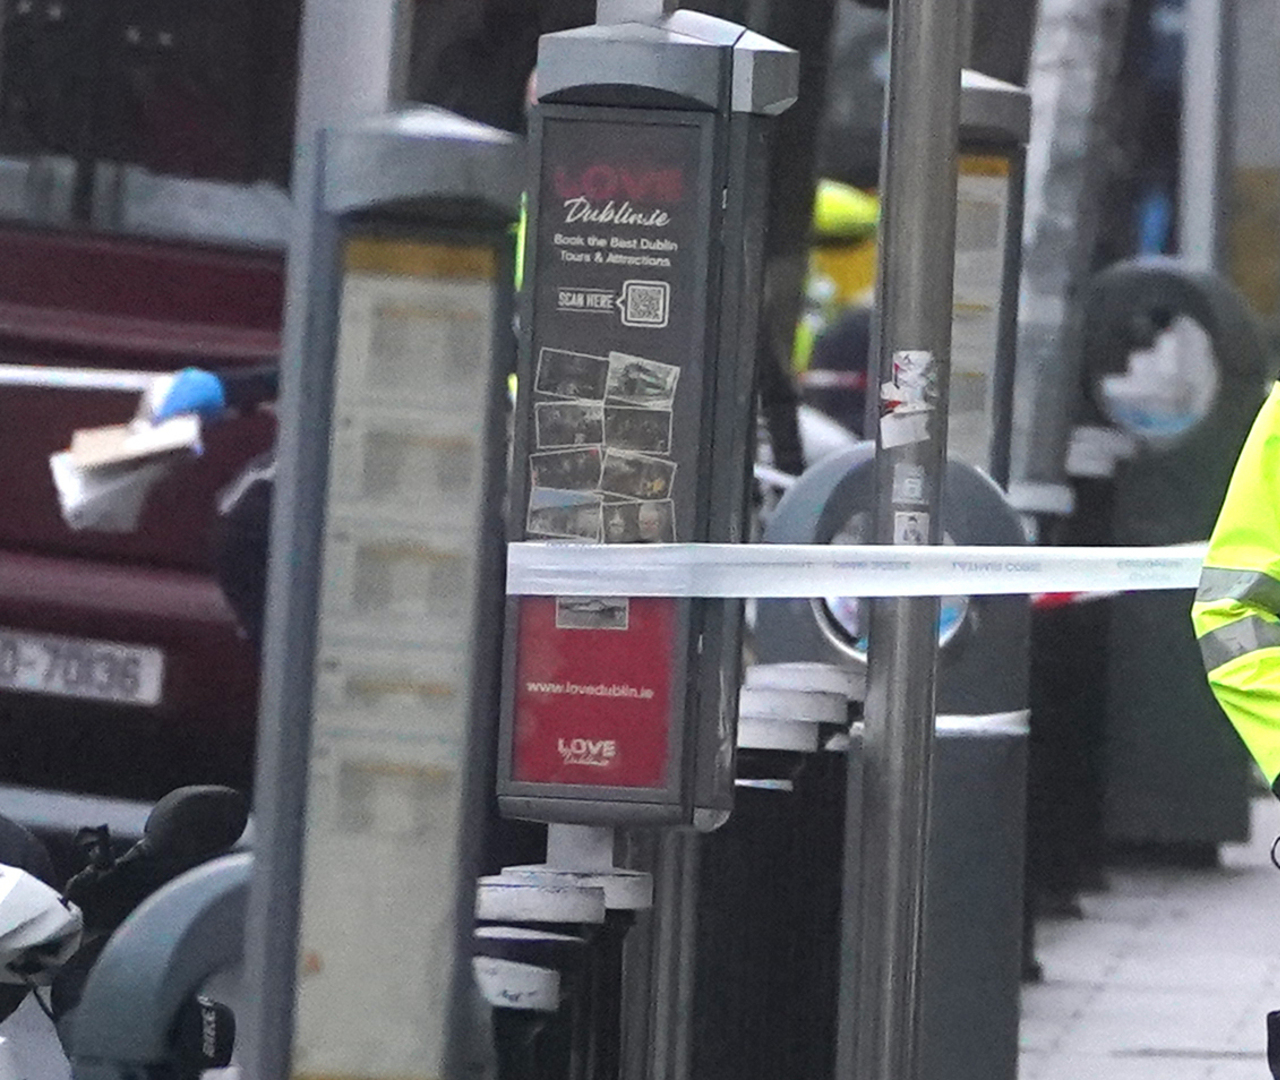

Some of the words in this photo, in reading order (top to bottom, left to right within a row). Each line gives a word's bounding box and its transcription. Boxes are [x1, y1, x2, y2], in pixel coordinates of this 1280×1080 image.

[553, 233, 585, 246] Book
[587, 235, 607, 247] the
[610, 237, 638, 249] Best
[640, 238, 679, 251] Dublin
[561, 250, 591, 262] Tours
[594, 251, 603, 263] &
[606, 252, 671, 267] Attractions
[558, 291, 585, 308] SCAN
[586, 294, 614, 309] HERE
[526, 681, 655, 699] www.lovedublin.ie
[557, 738, 617, 757] LOVE
